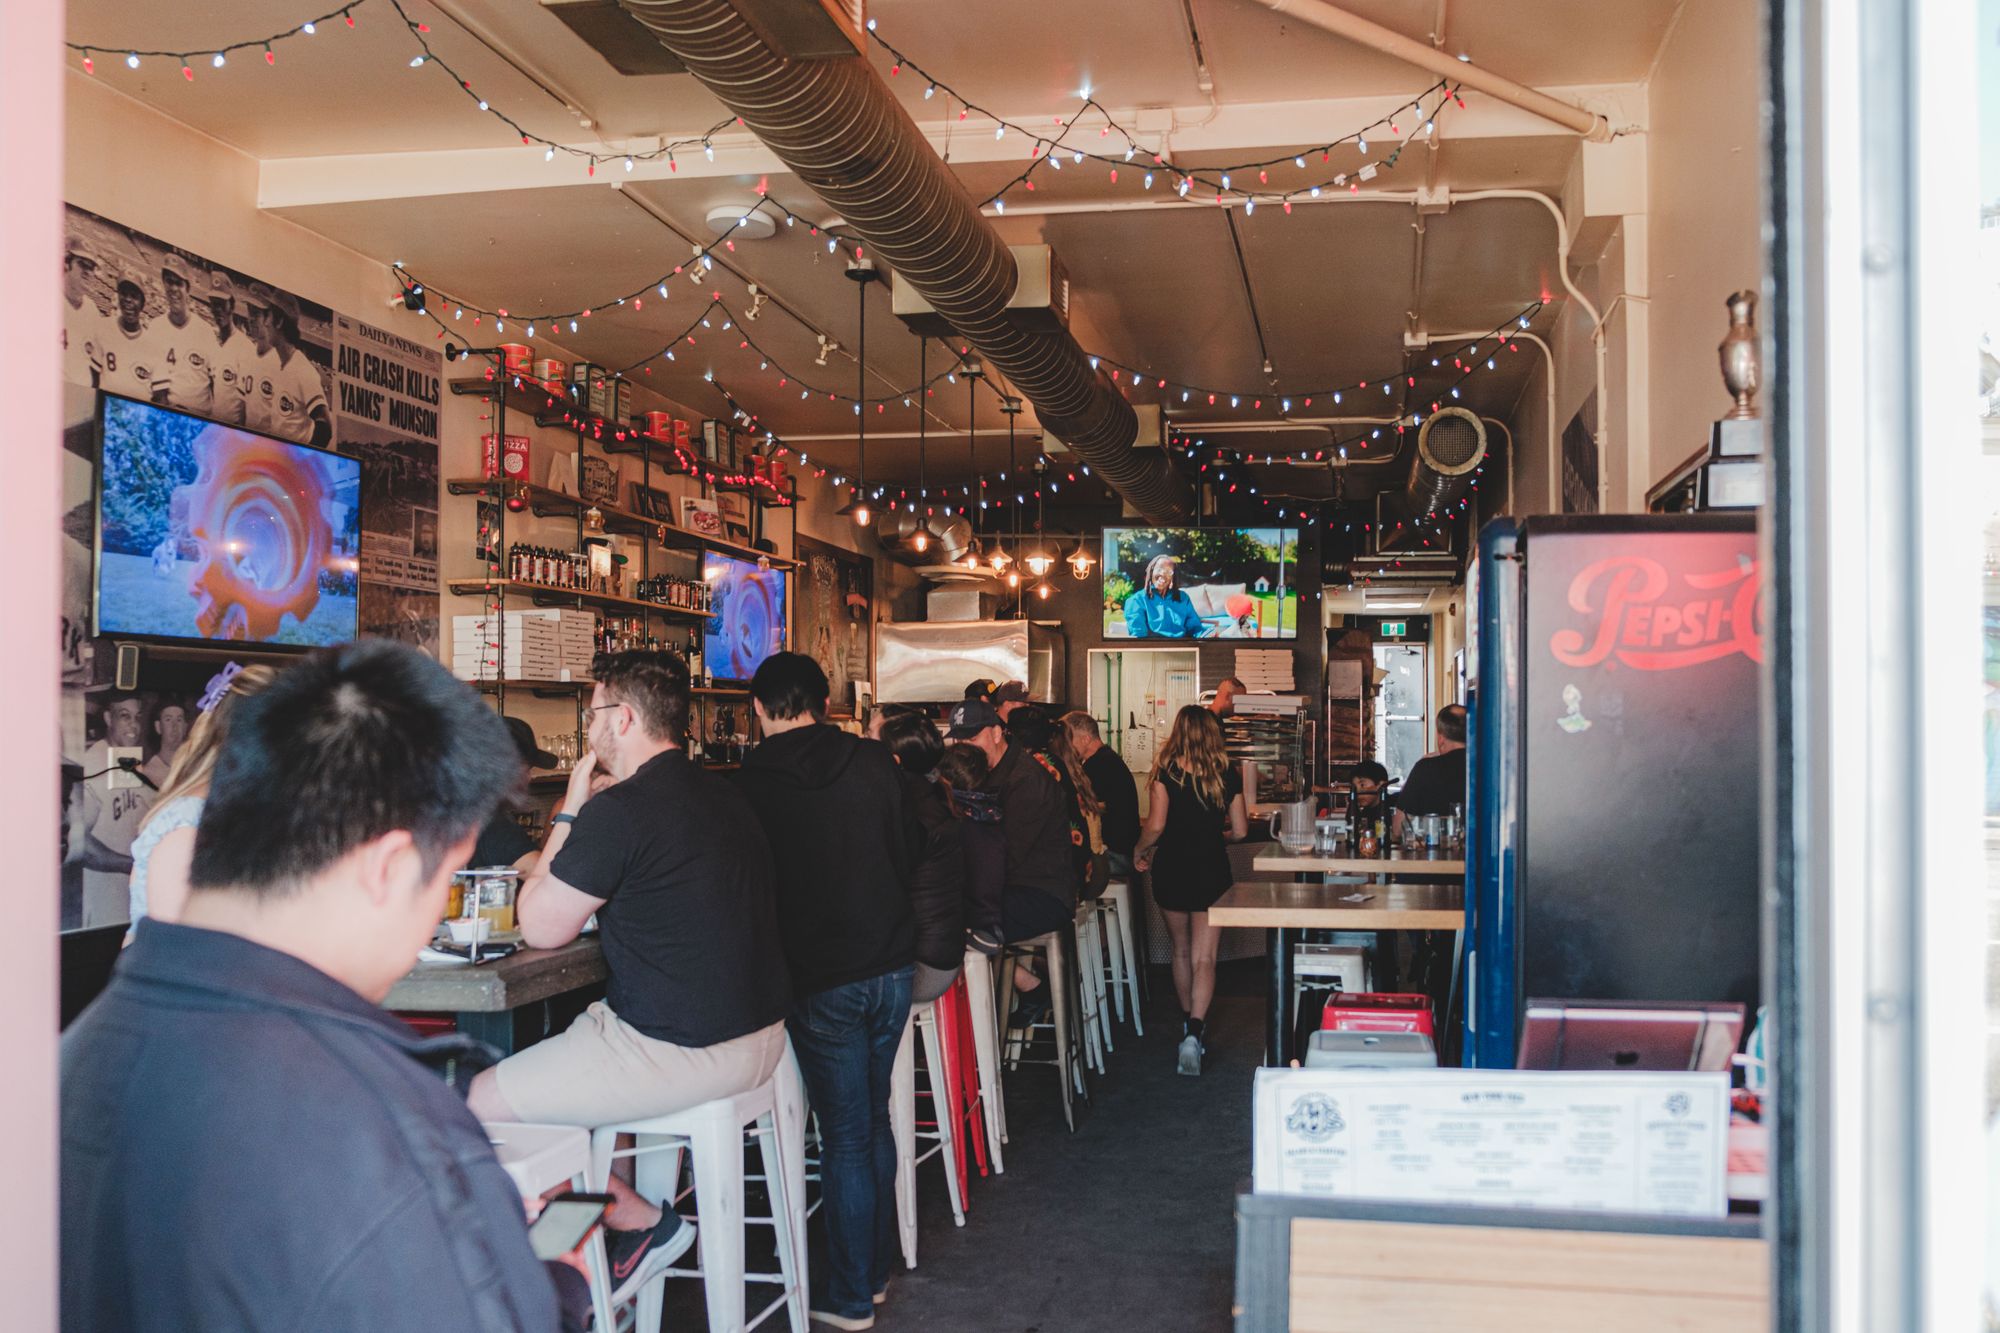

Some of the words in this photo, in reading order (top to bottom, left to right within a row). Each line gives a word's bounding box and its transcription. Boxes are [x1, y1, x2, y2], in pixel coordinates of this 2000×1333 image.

[359, 324, 391, 345] DAILY
[395, 338, 422, 358] NEWS
[106, 351, 117, 372] 8
[166, 347, 177, 366] 4
[338, 344, 361, 379] AIR
[363, 352, 404, 395] CRASH
[406, 368, 440, 407] KILLS
[339, 380, 385, 422] YANKS'
[389, 397, 438, 440] MUNSON
[504, 441, 526, 450] IZZA
